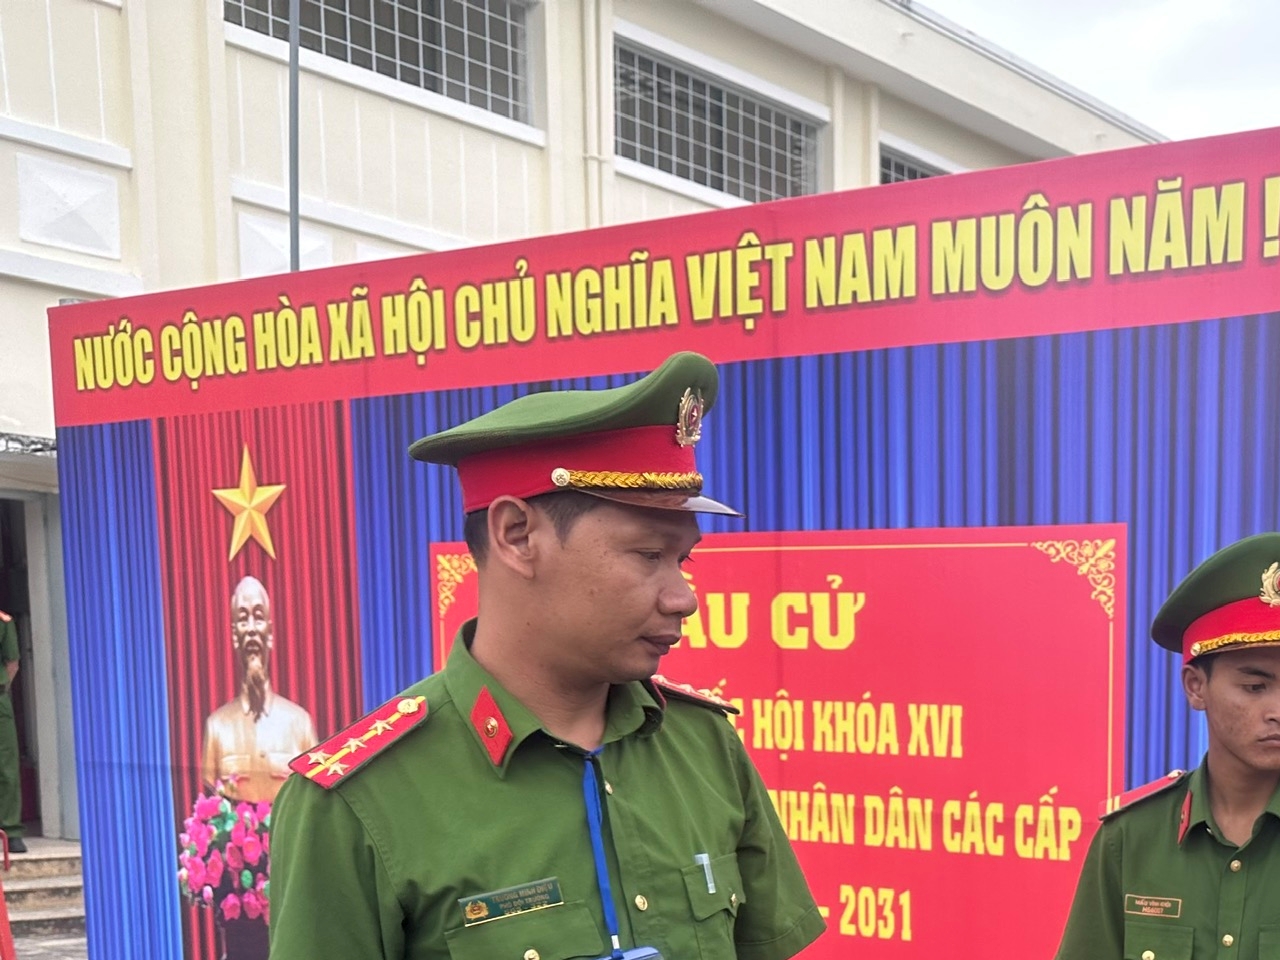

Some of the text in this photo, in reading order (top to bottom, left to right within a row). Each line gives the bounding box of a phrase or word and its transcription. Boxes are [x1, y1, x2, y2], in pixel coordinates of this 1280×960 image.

[74, 319, 155, 390] NƯỚC
[160, 311, 248, 390] CỘNG
[253, 296, 323, 370] HÒA
[327, 287, 375, 361] XÃ
[381, 278, 446, 365] HỘI
[454, 259, 536, 348] CHỦ
[545, 251, 679, 338] NGHĨA
[686, 232, 794, 329] VIỆT
[805, 226, 917, 309] NAM
[931, 193, 1092, 295] MUÔN
[1109, 176, 1246, 276] NĂM
[668, 570, 866, 650] ẦU CỬ
[752, 689, 805, 761] HỘI
[812, 691, 900, 755] KHÓA
[908, 703, 963, 758] XVI
[767, 782, 1082, 861] NHÂN DÂN CÁC CẤP
[839, 884, 912, 941] 2031
